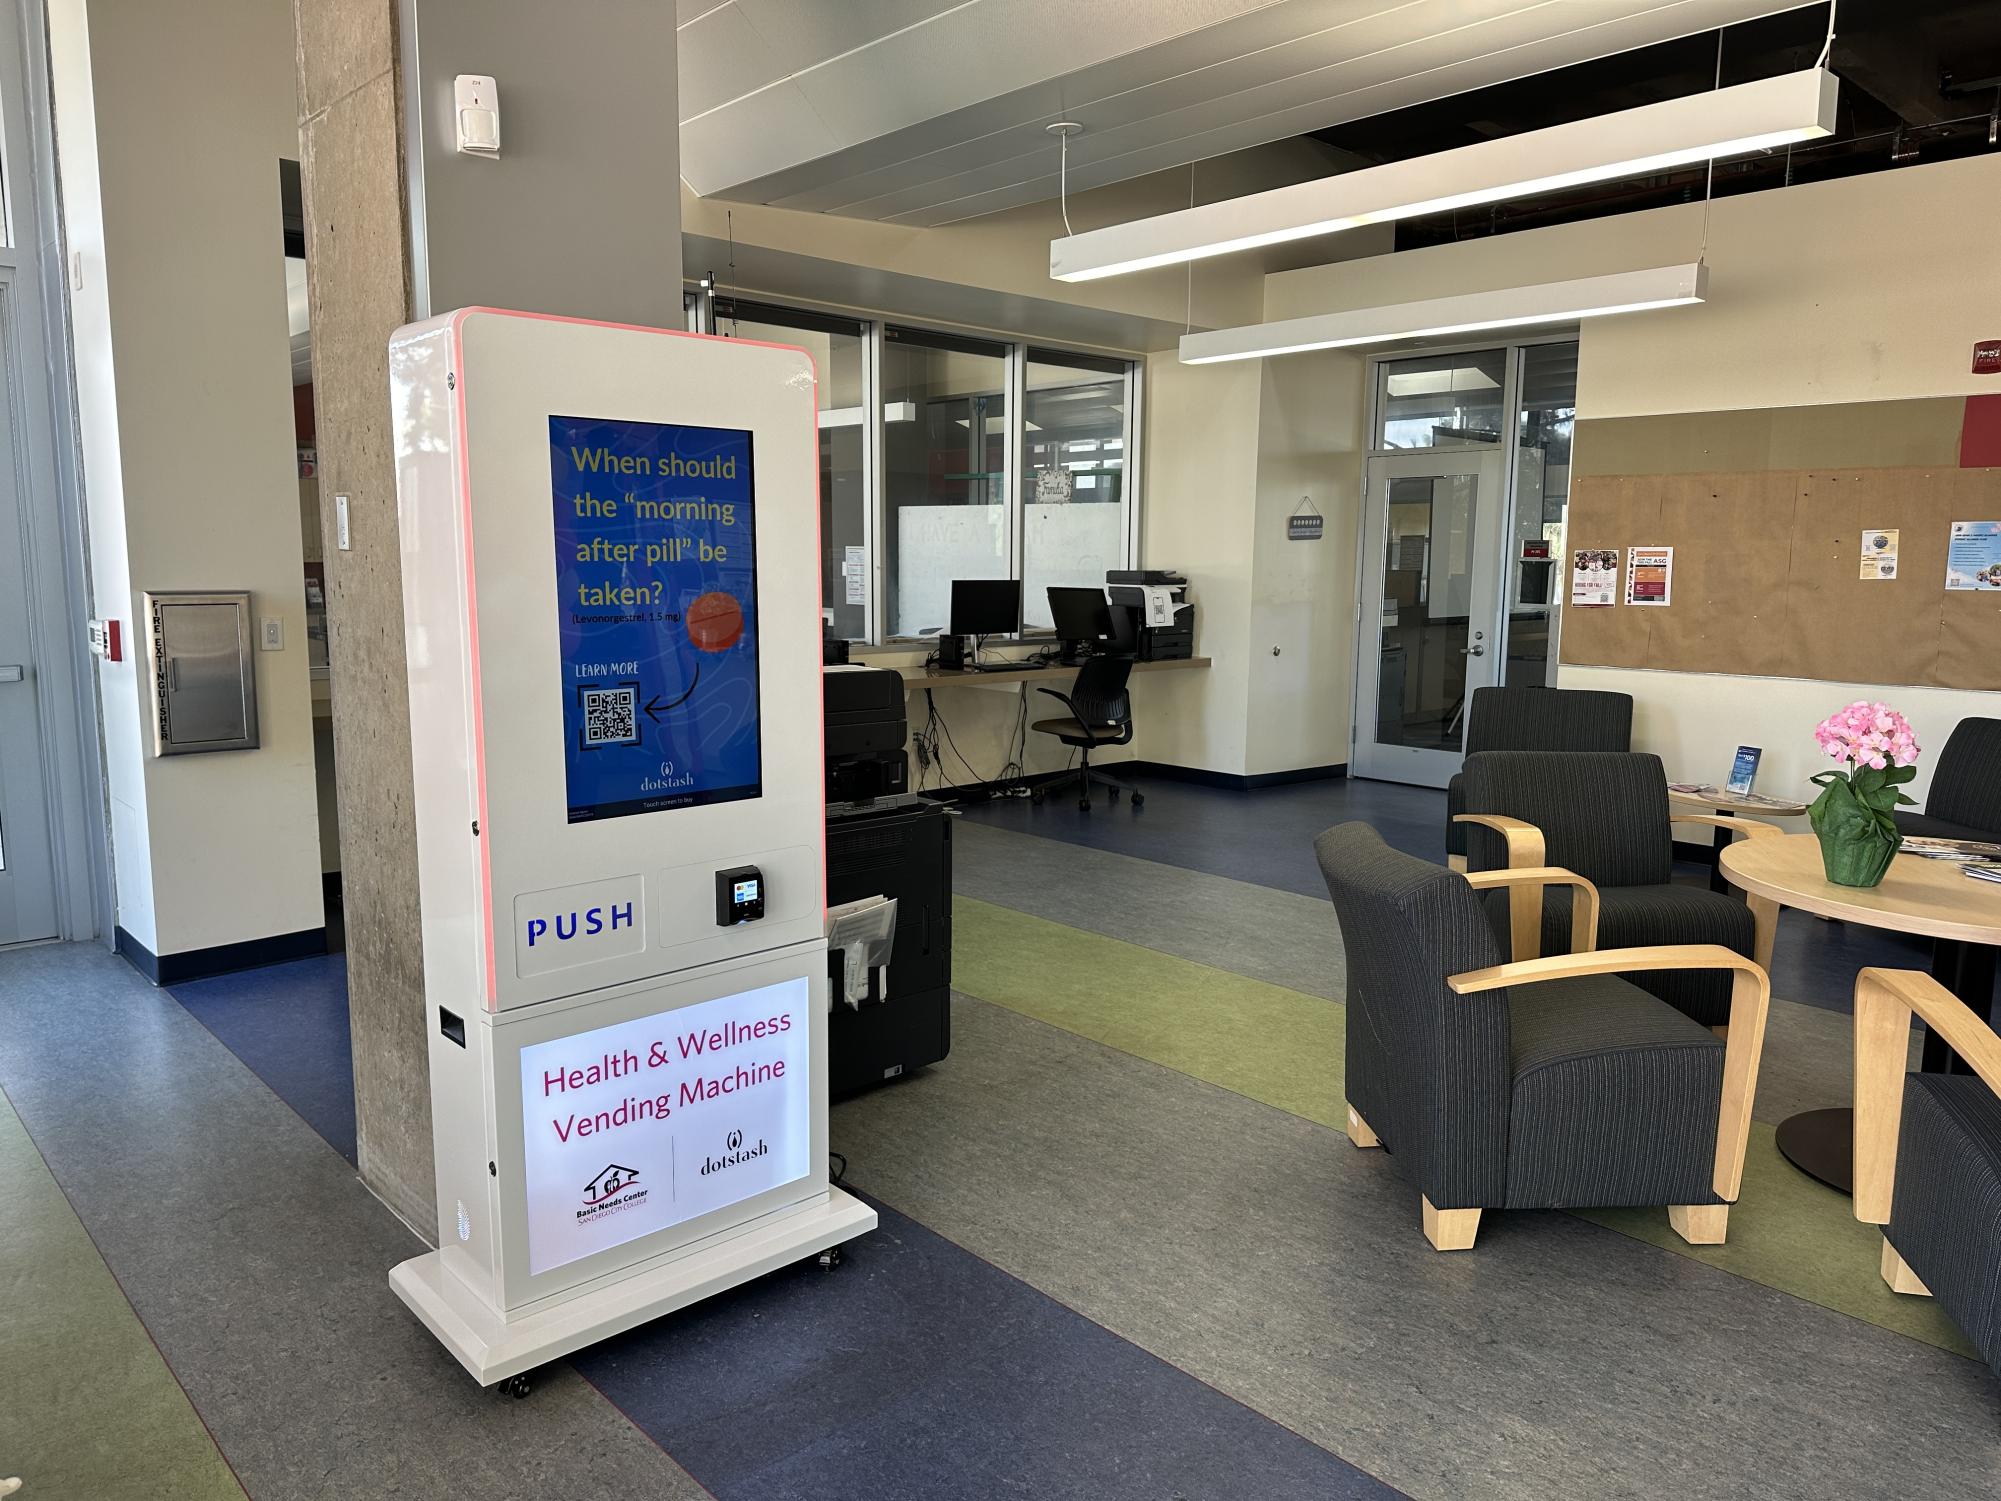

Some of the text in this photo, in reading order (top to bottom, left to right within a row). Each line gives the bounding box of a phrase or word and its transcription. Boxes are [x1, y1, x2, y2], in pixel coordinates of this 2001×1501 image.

[570, 446, 736, 480] When should
[573, 492, 617, 517] the
[576, 537, 639, 562] after
[699, 538, 727, 562] be
[578, 580, 663, 606] taken?
[649, 612, 663, 622] 1.5
[665, 611, 681, 623] mg)
[152, 600, 169, 741] FIRE EXTINGUISHER
[575, 660, 639, 678] LEARN MORE
[640, 771, 694, 791] dotstash
[527, 901, 633, 947] PUSH
[544, 1013, 791, 1096] Health & Wellness
[552, 1060, 786, 1143] Vending Machine
[700, 1138, 768, 1176] dotstash
[576, 1190, 648, 1219] Basic Needs Center
